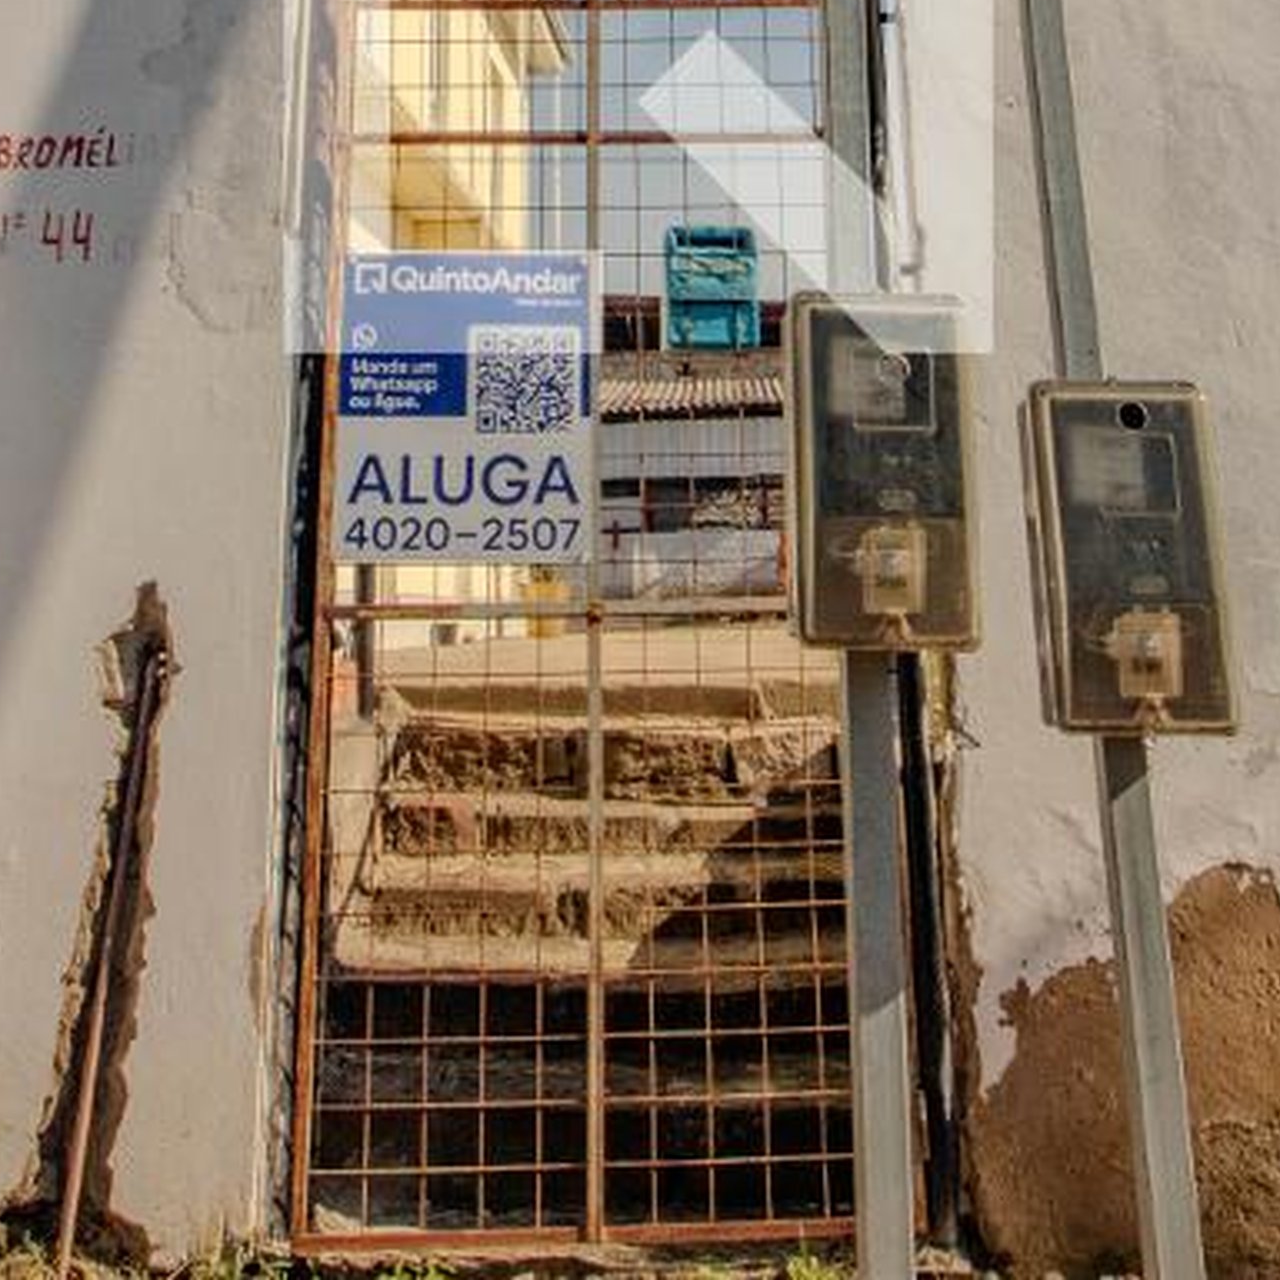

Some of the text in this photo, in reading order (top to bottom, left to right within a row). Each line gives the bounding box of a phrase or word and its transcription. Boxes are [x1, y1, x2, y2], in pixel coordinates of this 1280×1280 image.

[41, 208, 94, 263] 44
[390, 266, 582, 294] QuintoAndar
[347, 453, 580, 506] ALUGA
[344, 517, 580, 551] 4020-2507
